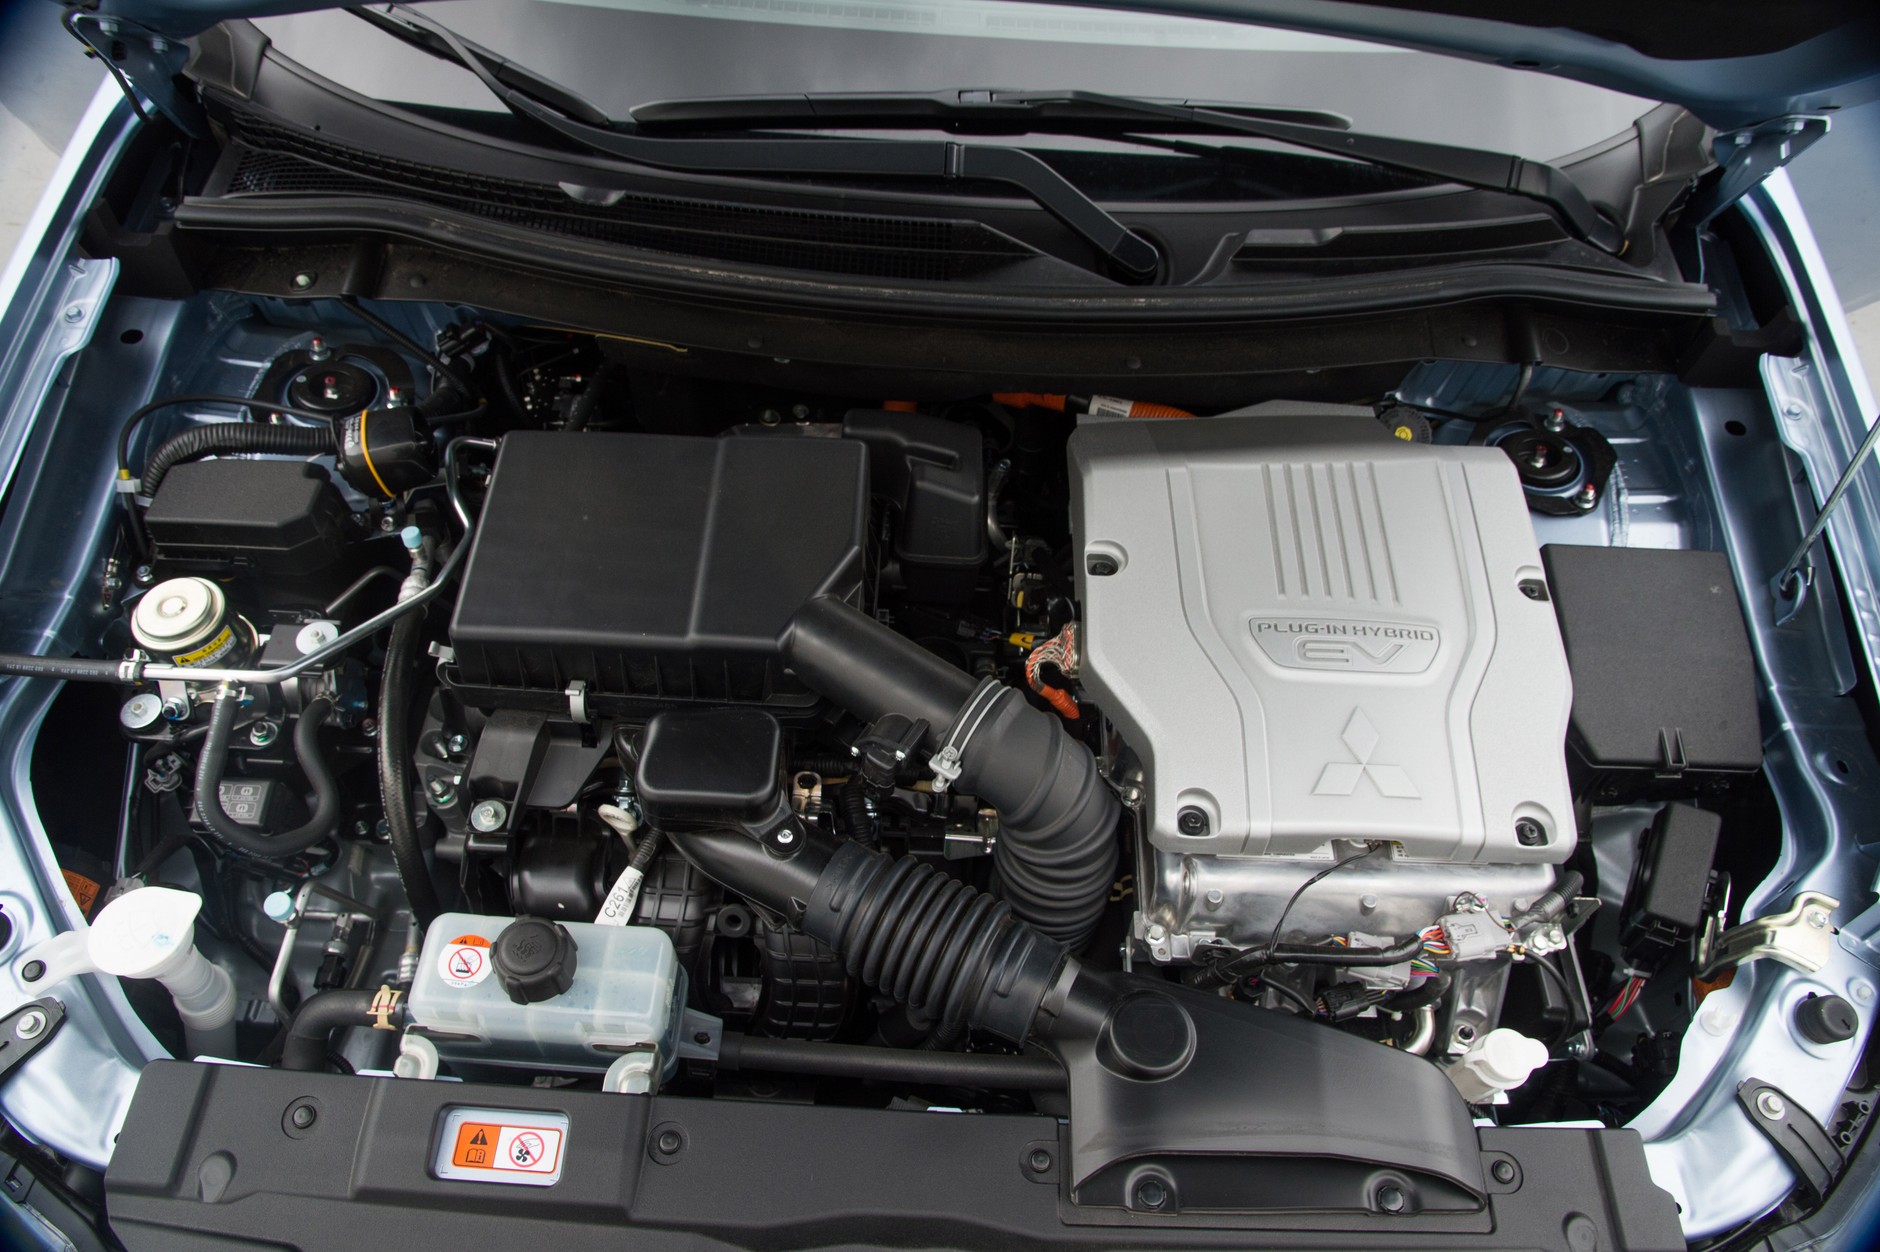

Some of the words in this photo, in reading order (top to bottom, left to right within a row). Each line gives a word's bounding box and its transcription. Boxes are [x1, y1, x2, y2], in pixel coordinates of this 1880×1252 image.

[1257, 623, 1347, 636] PLUG-IN
[1352, 625, 1434, 640] HYBRID
[1295, 638, 1406, 666] EV
[604, 886, 628, 917] C261
